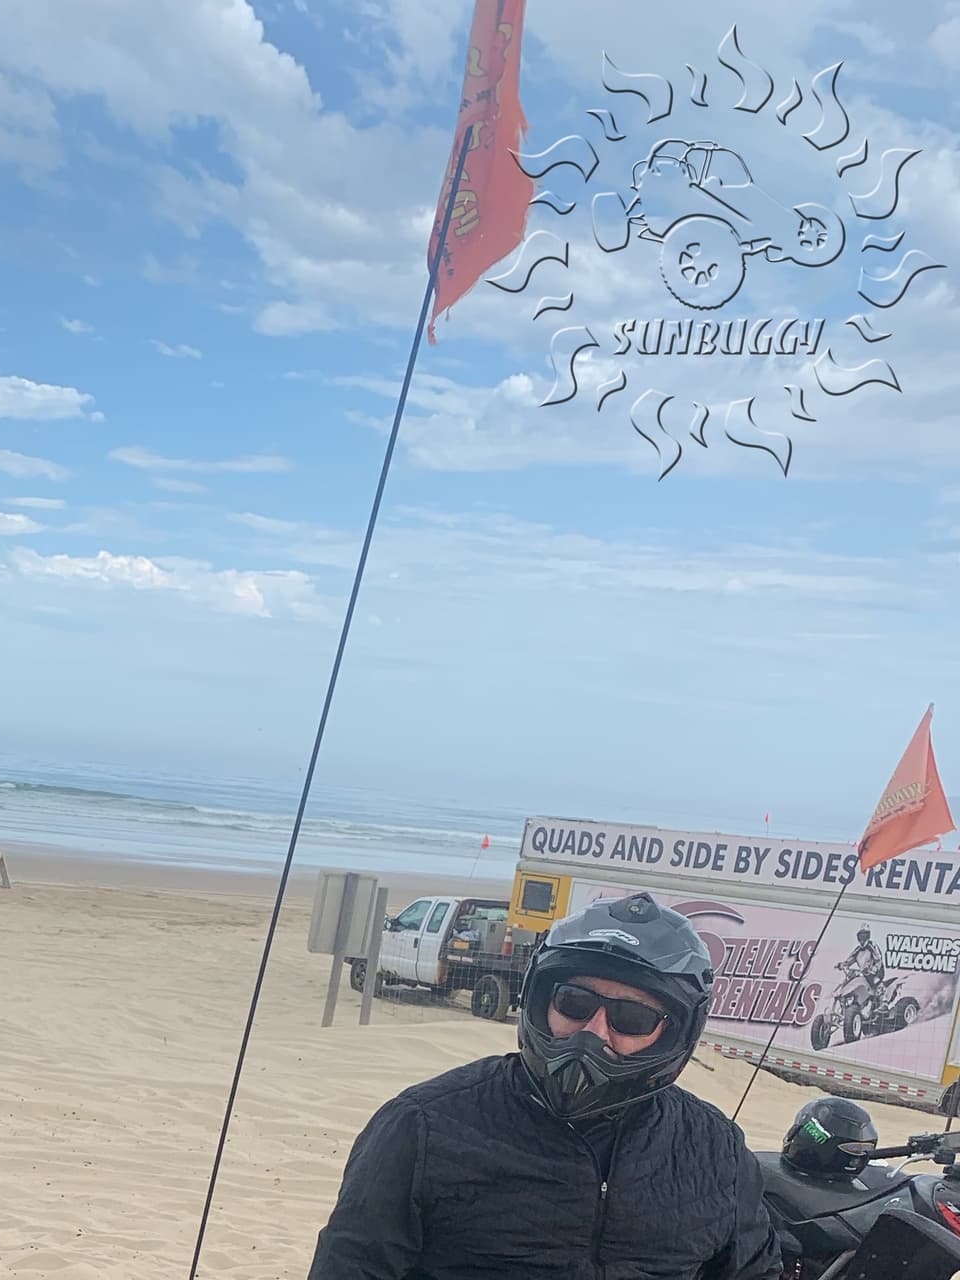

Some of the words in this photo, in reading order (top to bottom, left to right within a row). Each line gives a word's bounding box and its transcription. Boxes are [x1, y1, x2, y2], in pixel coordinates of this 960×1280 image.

[532, 827, 606, 858] QUADS
[610, 834, 664, 864] AND
[670, 839, 728, 872] SIDE
[734, 845, 771, 875] BY
[774, 848, 860, 885] SIDES
[885, 950, 958, 973] WELCOME
[886, 933, 960, 956] WALK-UPS
[708, 976, 823, 1027] RENTALS
